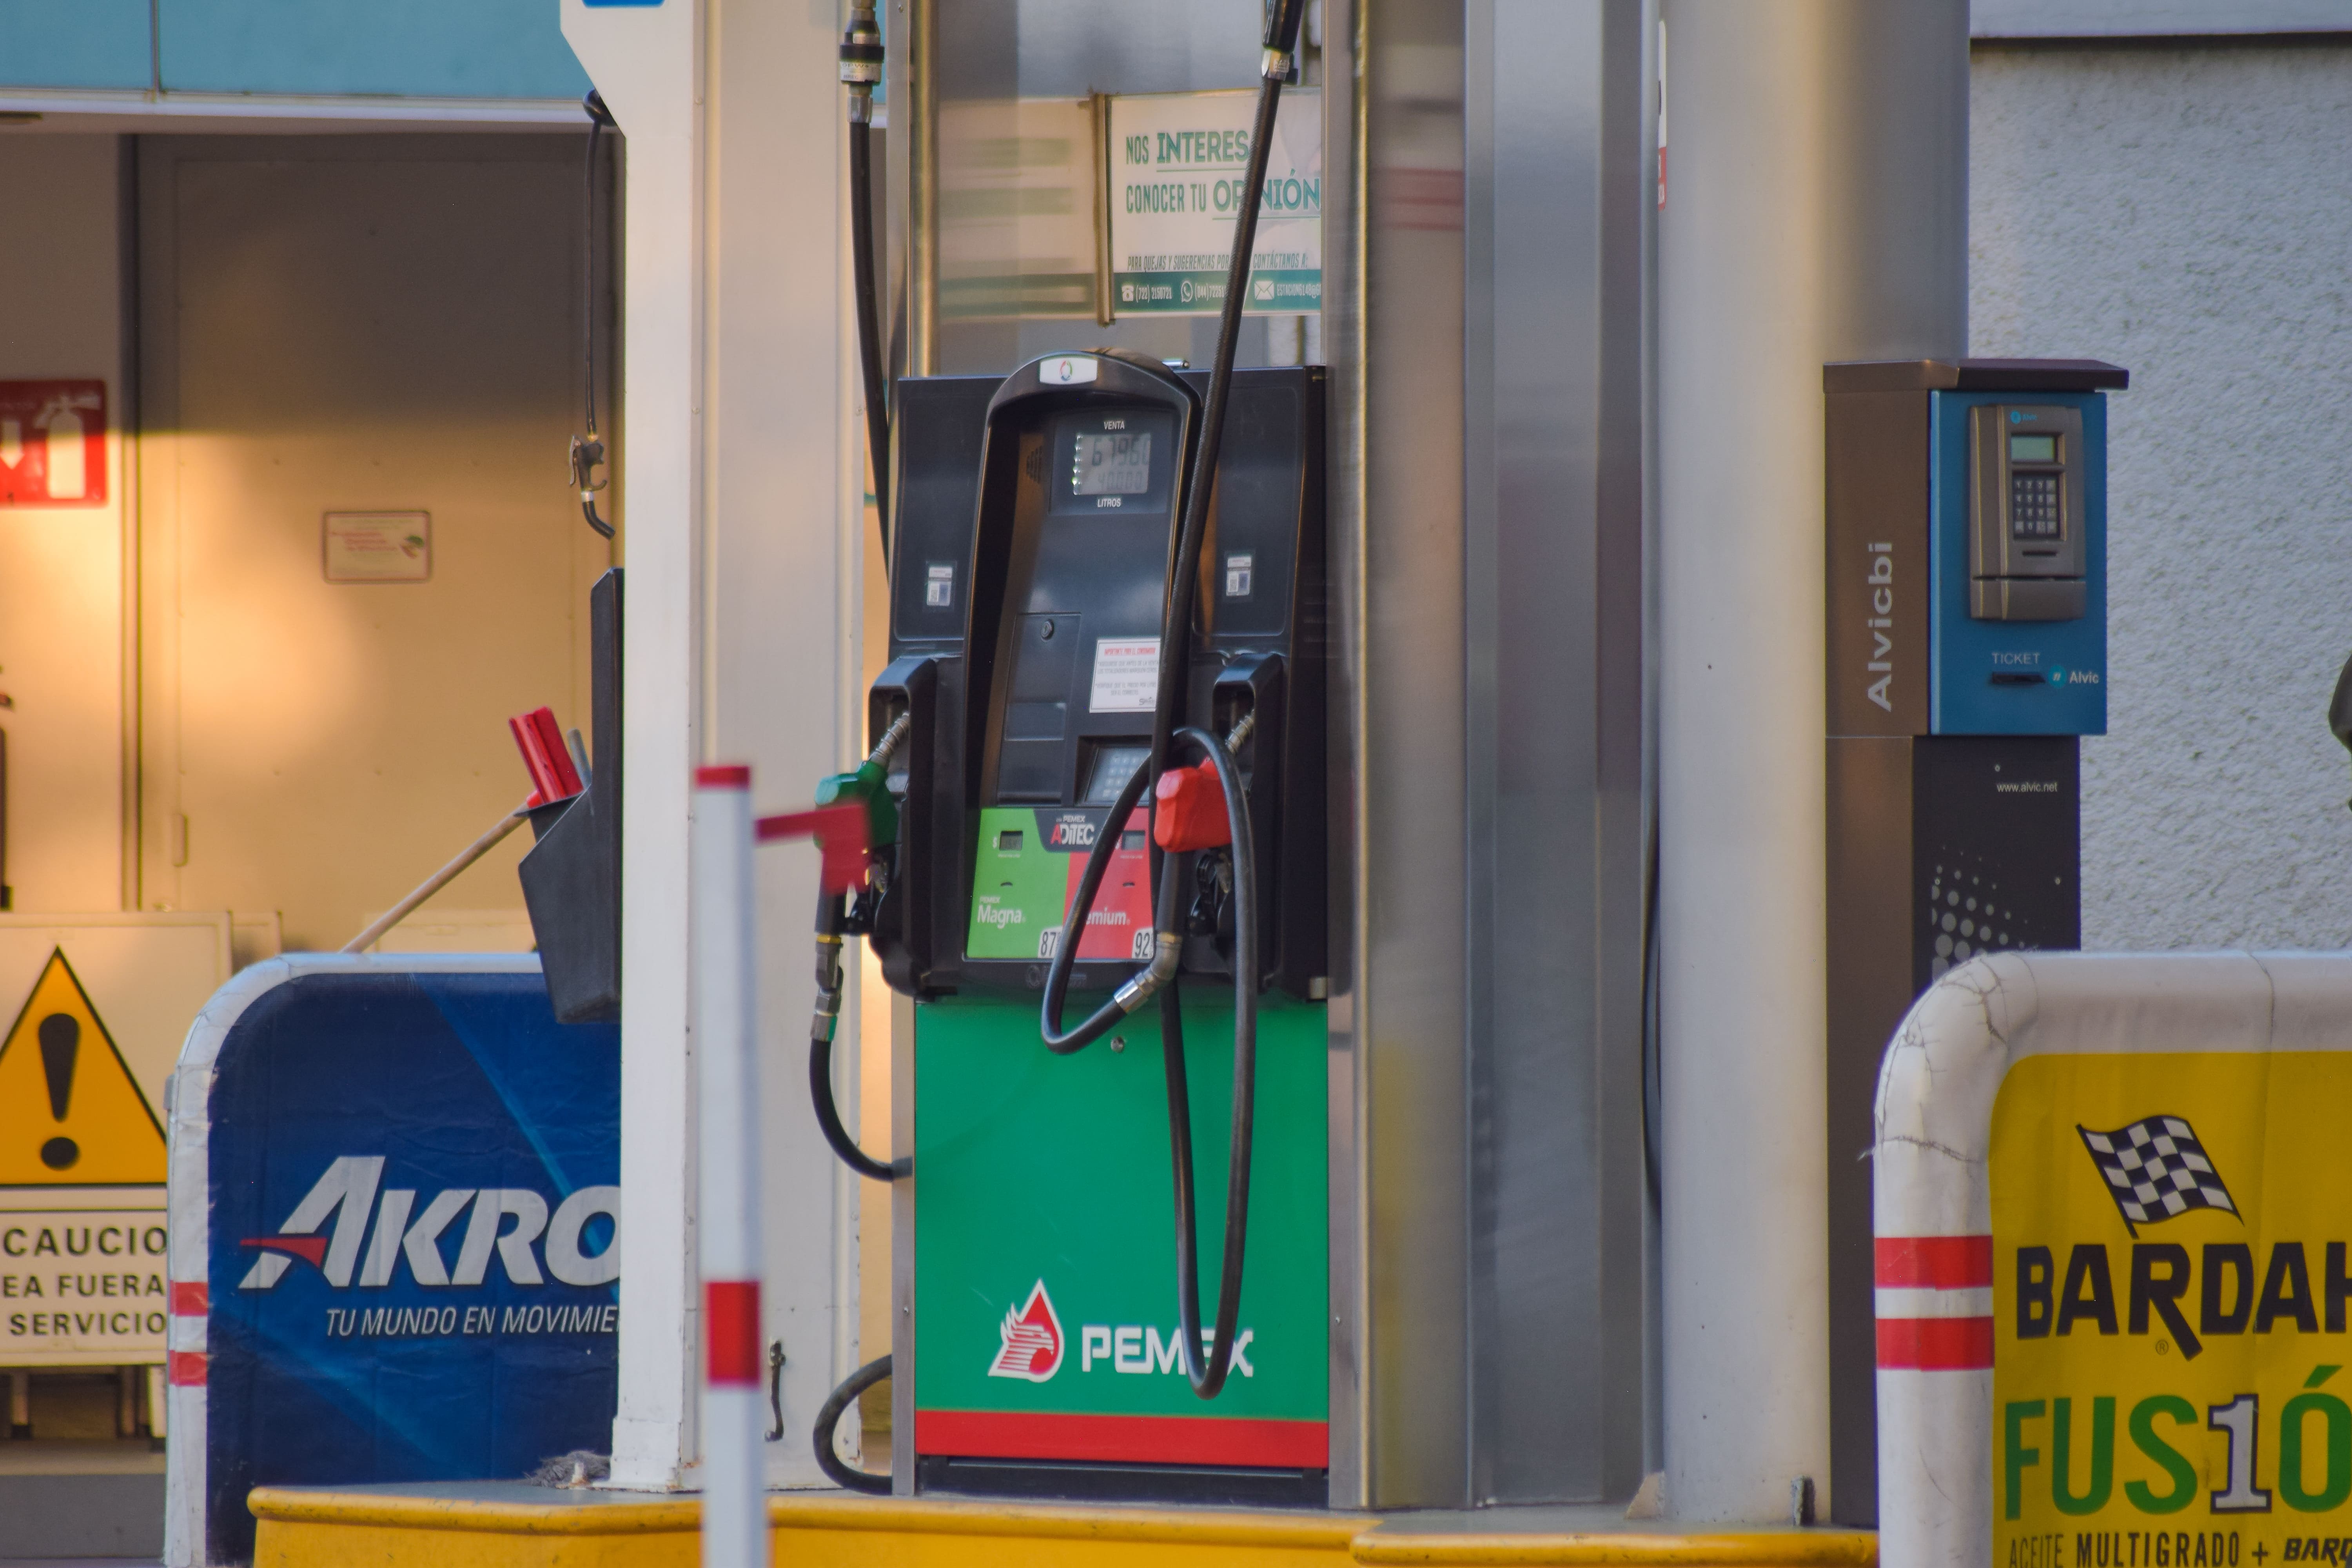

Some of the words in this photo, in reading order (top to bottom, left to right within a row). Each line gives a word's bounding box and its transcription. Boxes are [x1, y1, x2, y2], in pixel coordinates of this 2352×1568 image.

[1126, 136, 1149, 165] NOS
[1157, 131, 1250, 163] INTERES
[1126, 184, 1185, 214] CONOCER
[1190, 183, 1207, 212] TU
[1213, 168, 1320, 212] OPNIÓN
[1127, 256, 1142, 270] PARA
[1144, 255, 1166, 270] QUEJAS
[1169, 256, 1172, 270] Y
[1173, 255, 1214, 270] SUGERENCIAS
[1104, 420, 1125, 430] VENTA
[1097, 497, 1122, 508] LITROS
[1867, 543, 1892, 712] Alvicbi
[1992, 652, 2040, 664] TICKET
[2070, 671, 2099, 684] Alvic
[1997, 782, 2058, 793] www.alvic.net
[977, 905, 1021, 929] Magna
[1040, 932, 1056, 959] 87
[1135, 933, 1150, 957] 92
[3, 1227, 167, 1256] CAUCIO
[3, 1274, 43, 1297] EA
[58, 1274, 165, 1297] FUERA
[10, 1312, 167, 1335] SERVICIO
[326, 1309, 356, 1336] TU
[361, 1307, 457, 1336] MUNDO
[463, 1307, 496, 1334] EN
[502, 1305, 619, 1334] MOVIMIE
[2010, 1534, 2064, 1568] ACEITE
[2077, 1532, 2239, 1568] MULTIGRADO
